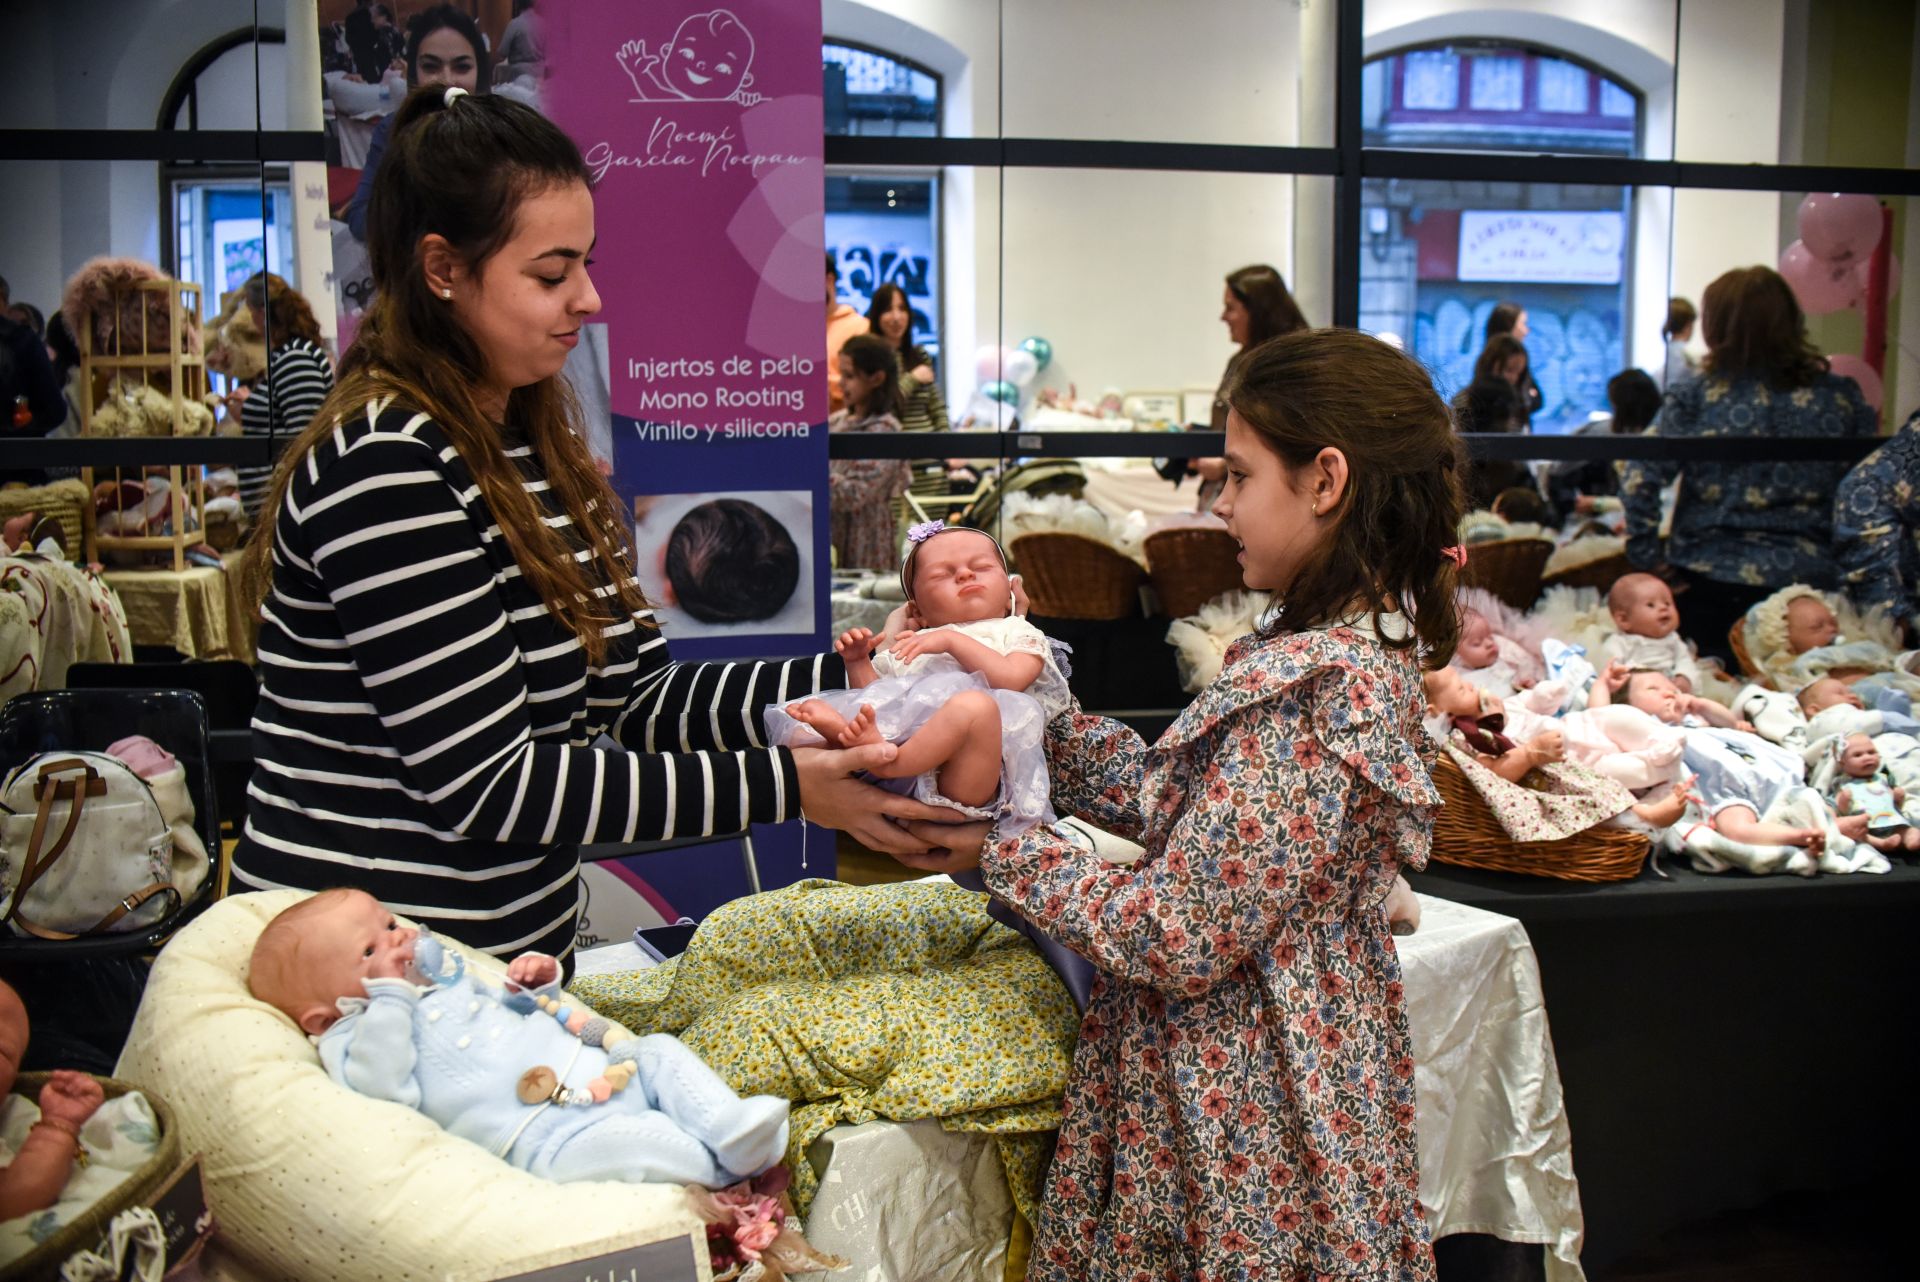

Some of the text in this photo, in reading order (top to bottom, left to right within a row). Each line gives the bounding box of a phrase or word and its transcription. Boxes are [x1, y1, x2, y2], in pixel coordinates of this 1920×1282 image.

[628, 354, 814, 383] Injertos de pelo
[639, 386, 805, 411] Mono Rooting
[634, 417, 810, 443] Vinilo y silicona
